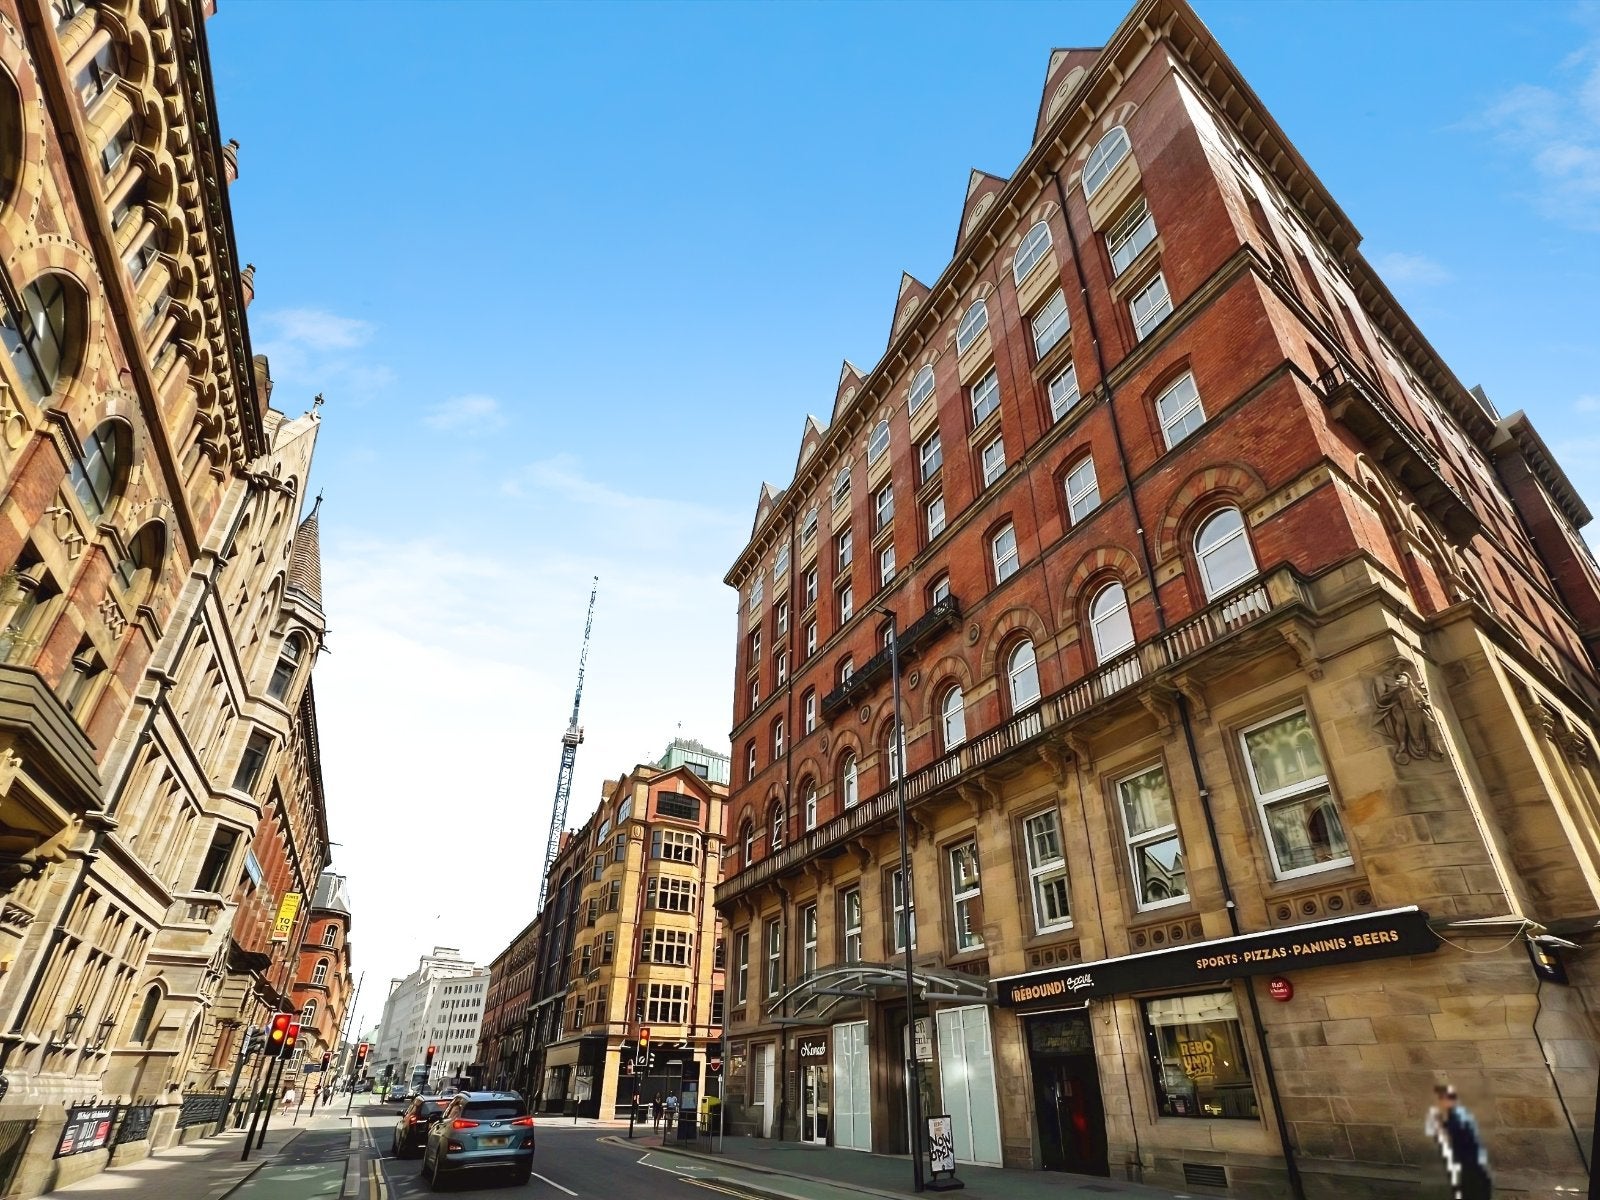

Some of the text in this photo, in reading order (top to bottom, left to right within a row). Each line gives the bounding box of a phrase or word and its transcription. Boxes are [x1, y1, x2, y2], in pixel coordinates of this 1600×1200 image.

[1196, 930, 1399, 969] SPORTS PIZZAS PANINIS BEERS
[929, 1131, 951, 1151] NOW
